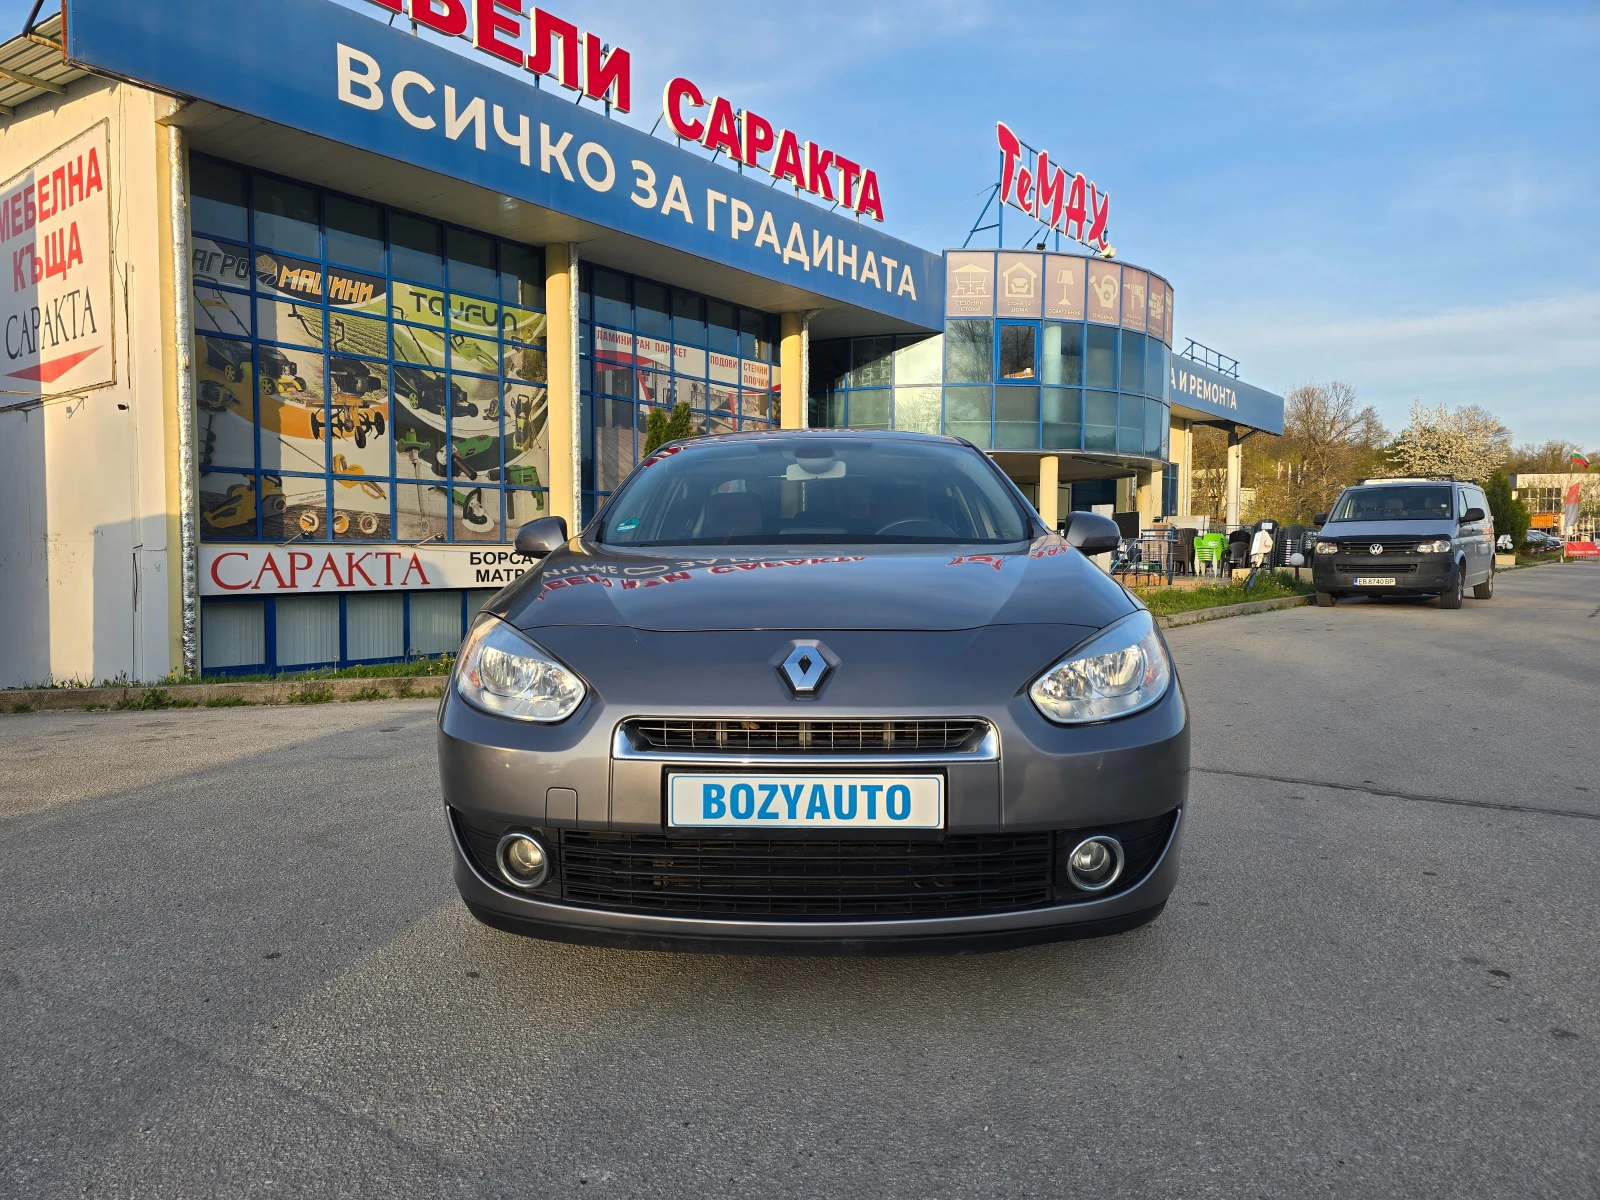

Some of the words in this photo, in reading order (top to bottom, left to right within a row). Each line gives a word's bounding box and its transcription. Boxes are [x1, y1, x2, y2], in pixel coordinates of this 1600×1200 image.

[364, 0, 630, 114] ЕЛИ
[663, 77, 884, 222] САРАКТА
[336, 42, 615, 192] ВСИЧКО
[630, 160, 694, 224] ЗА
[707, 188, 917, 300] ГРАДИНАТА
[0, 147, 103, 243] МЕБЕЛНА
[12, 221, 83, 292] КЪЩА
[192, 249, 250, 279] АГРО
[278, 265, 373, 304] МАШИНИ
[5, 285, 97, 359] САРАКТА
[597, 329, 650, 350] ЛАМИНИРАН
[655, 342, 687, 358] ПАРКЕТ
[710, 355, 737, 369] ПОДОВИ
[743, 362, 768, 375] СТЕННИ
[743, 374, 769, 387] ПЛОЧКИ
[1179, 370, 1187, 392] И
[1190, 374, 1237, 410] РЕМОНТА
[210, 551, 430, 590] САРАКТА
[470, 552, 533, 565] БОРСА
[702, 783, 912, 820] BOZYAUTO
